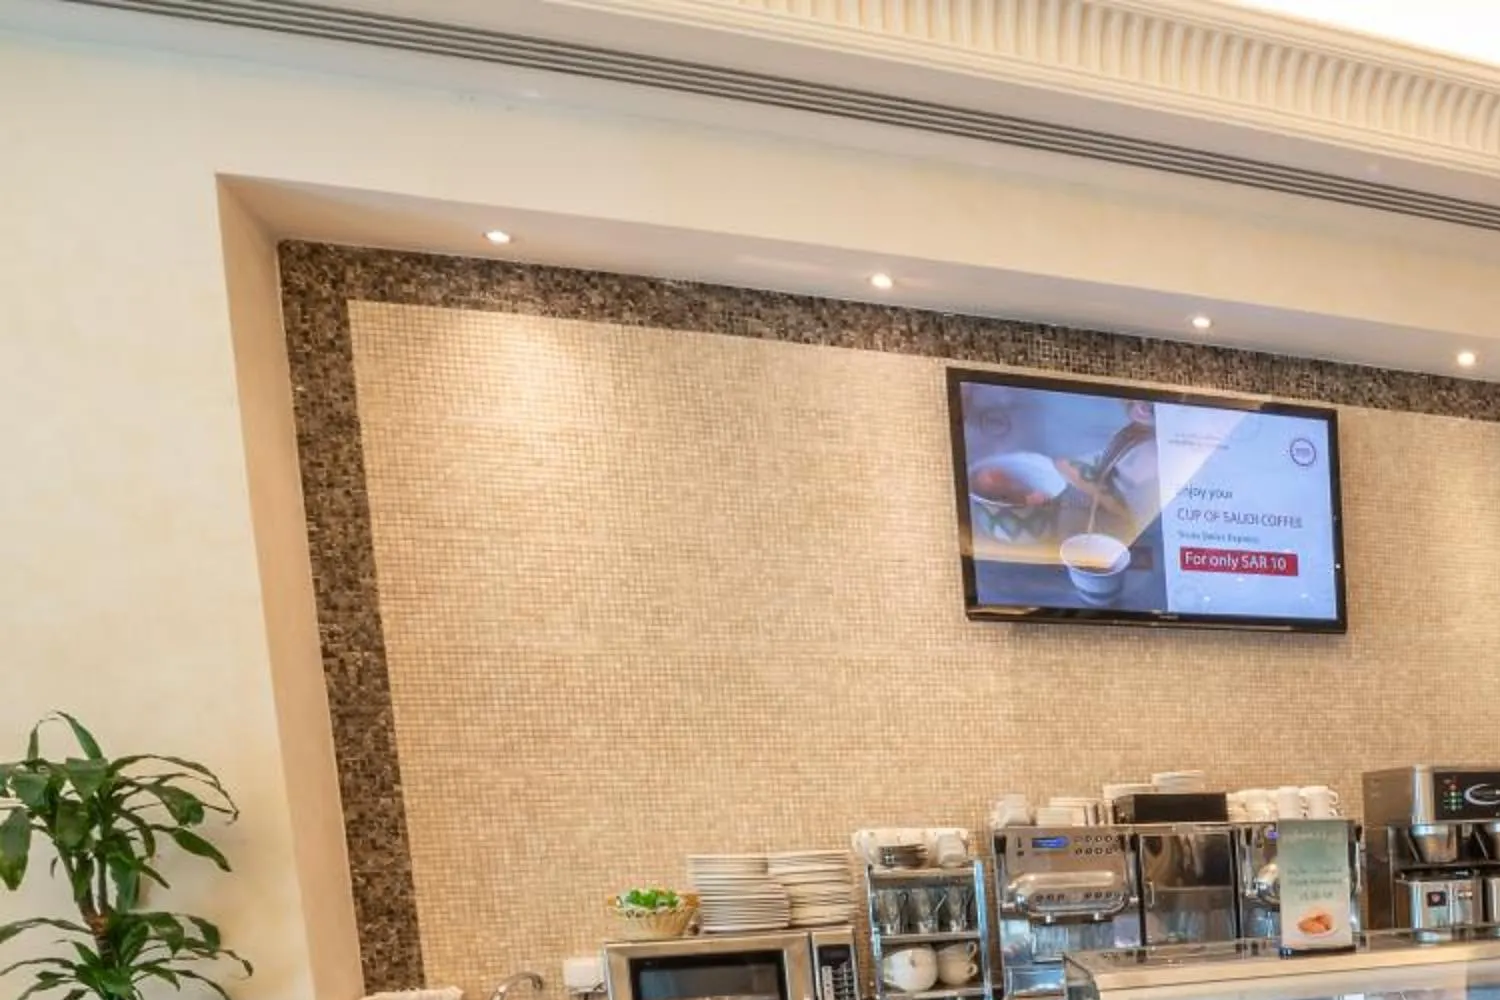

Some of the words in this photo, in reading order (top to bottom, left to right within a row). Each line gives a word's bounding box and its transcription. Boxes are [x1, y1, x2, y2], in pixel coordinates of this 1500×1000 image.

[1208, 487, 1233, 501] your
[1177, 507, 1202, 522] CUP
[1203, 510, 1221, 523] OF
[1223, 511, 1258, 527] SAUDI
[1261, 513, 1304, 530] COFFEE
[1184, 550, 1208, 567] For
[1209, 552, 1239, 571] only
[1240, 555, 1268, 570] SAR
[1270, 556, 1288, 571] 10
